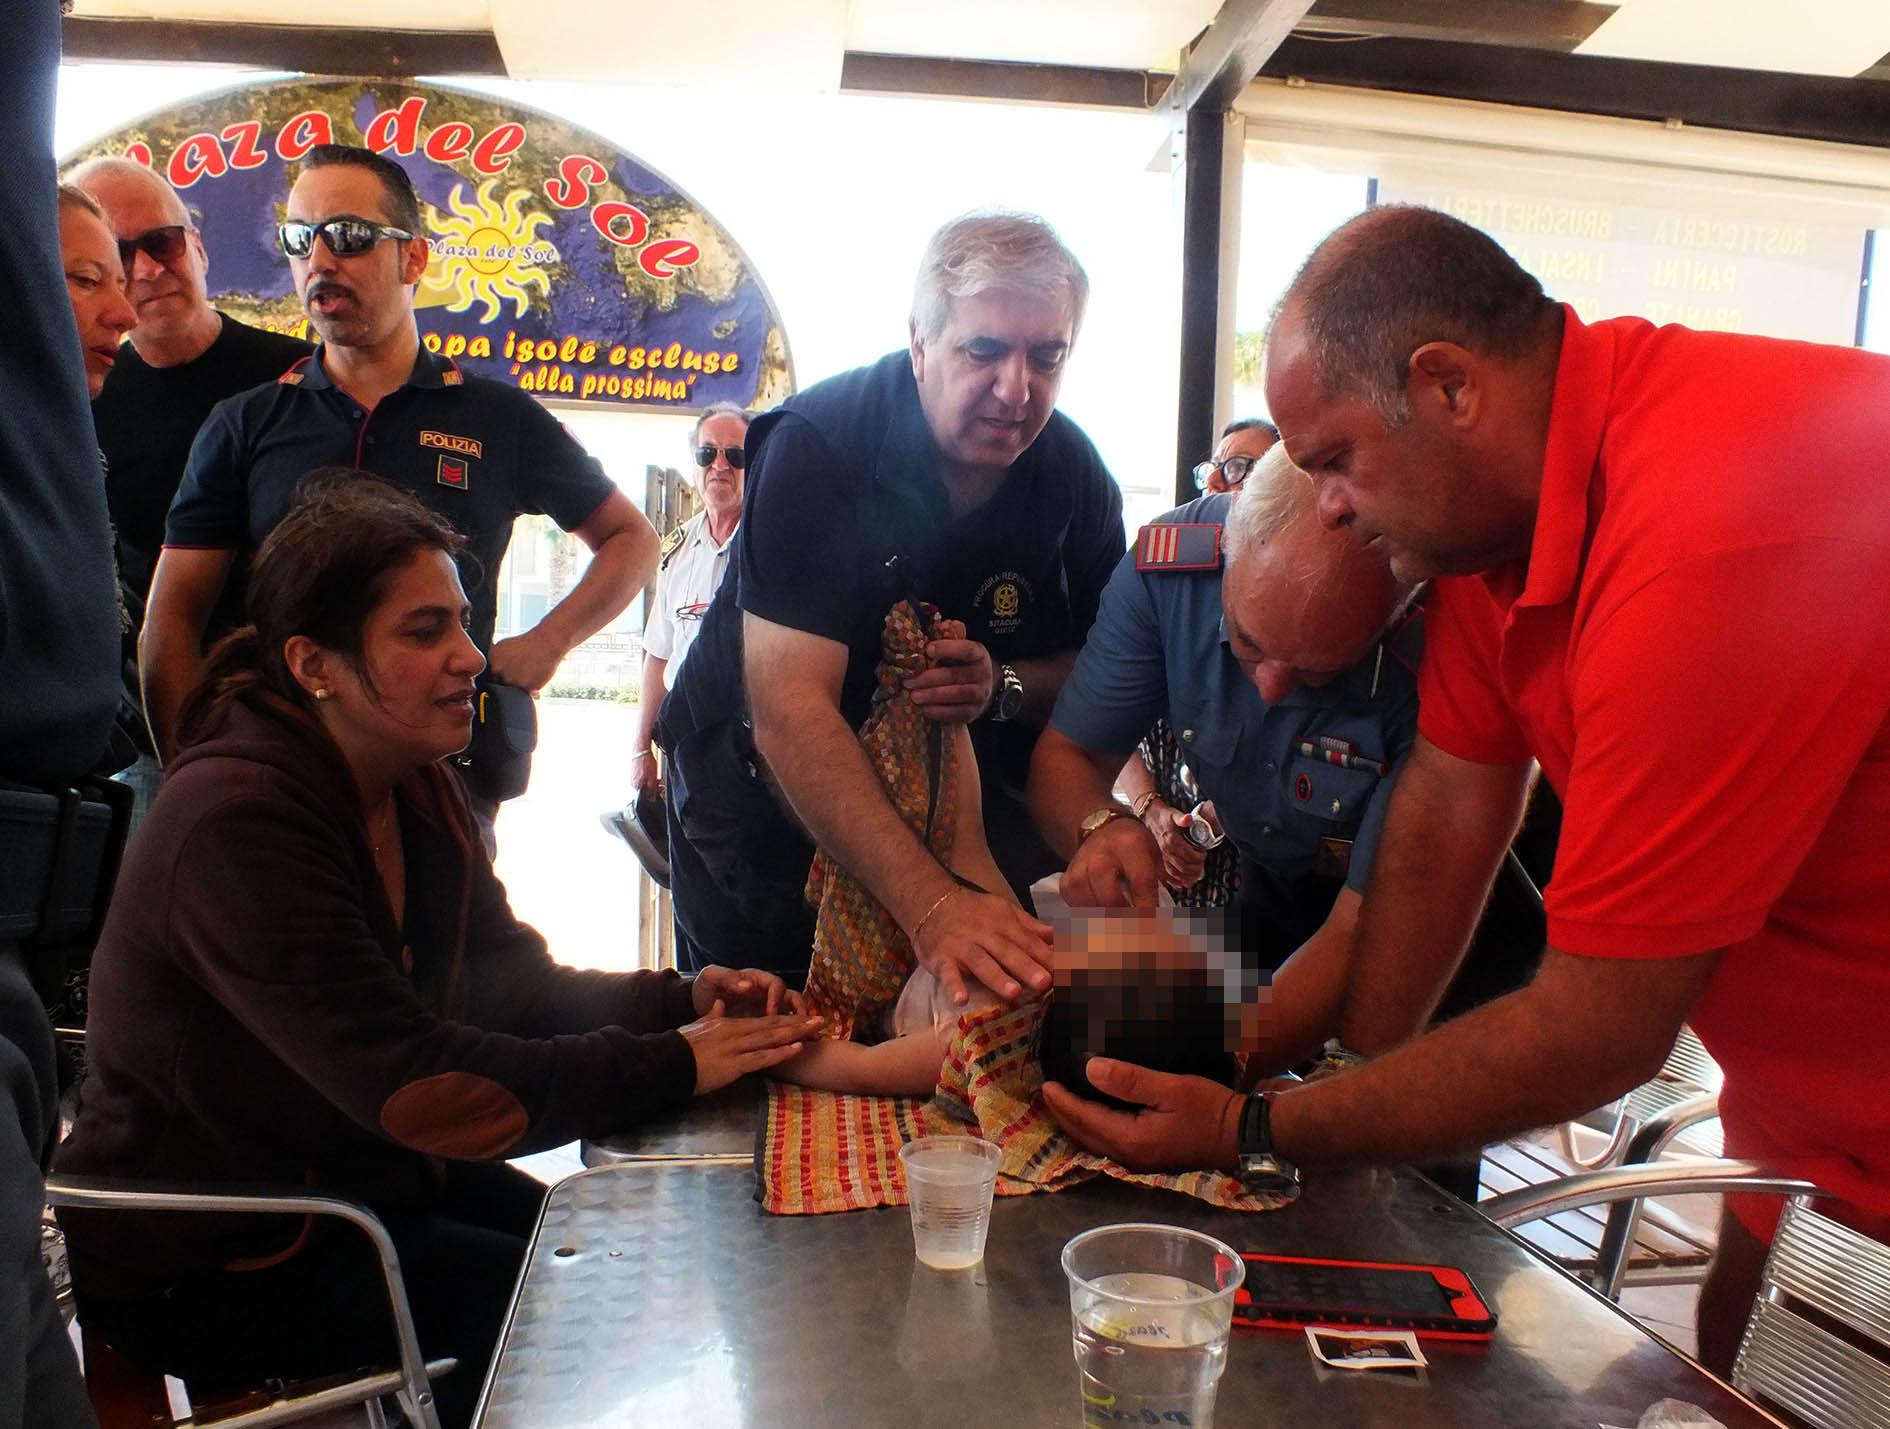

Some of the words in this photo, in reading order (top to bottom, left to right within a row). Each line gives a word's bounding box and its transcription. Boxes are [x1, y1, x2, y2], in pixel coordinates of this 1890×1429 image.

[124, 110, 333, 188] aza
[364, 96, 526, 175] del
[485, 244, 516, 259] del
[522, 245, 557, 263] Sol
[422, 332, 491, 358] opa
[504, 329, 597, 364] isole
[609, 343, 739, 374] escluse
[423, 433, 480, 456] POLIZIA
